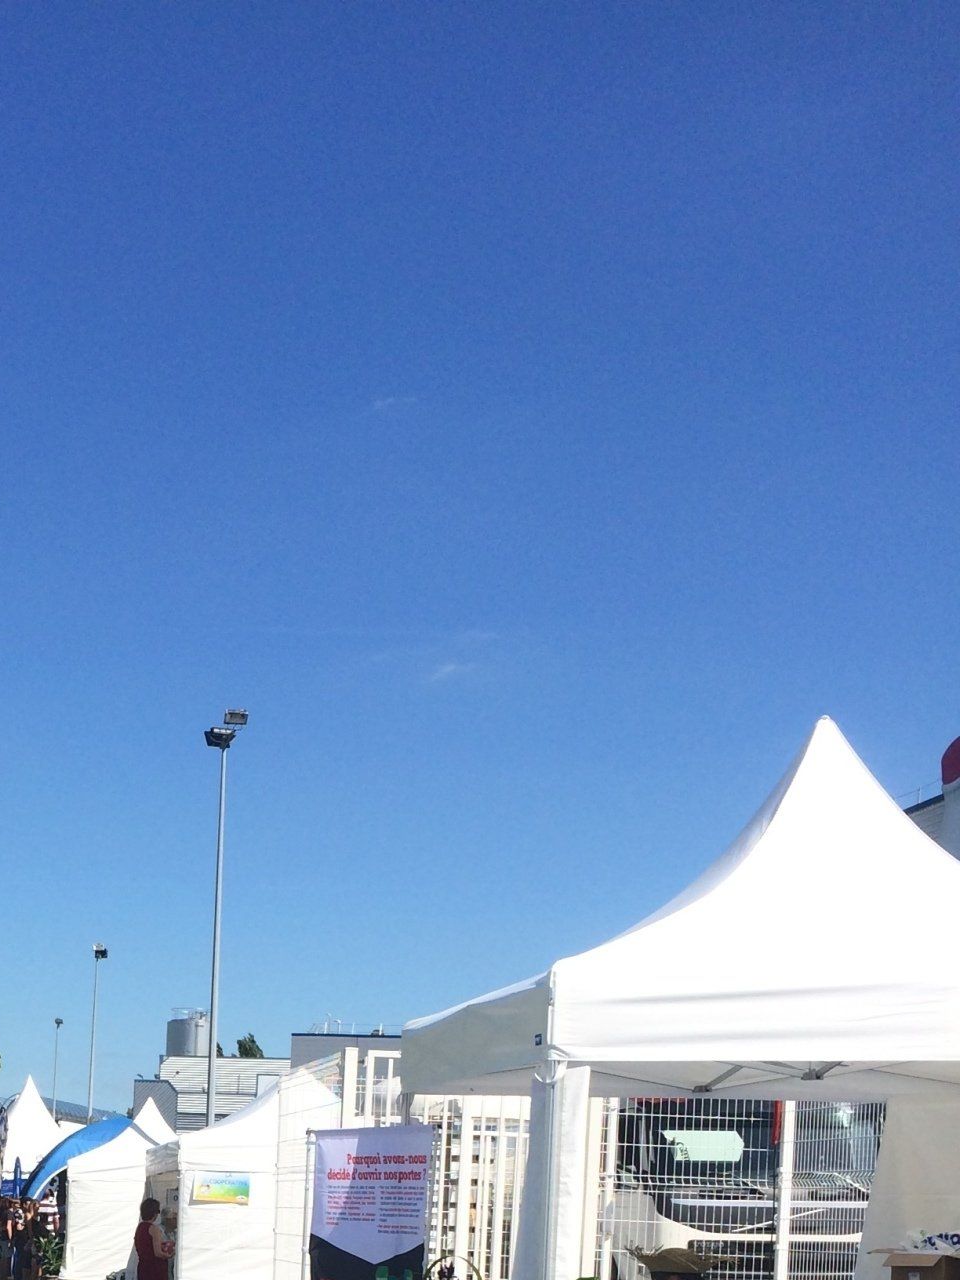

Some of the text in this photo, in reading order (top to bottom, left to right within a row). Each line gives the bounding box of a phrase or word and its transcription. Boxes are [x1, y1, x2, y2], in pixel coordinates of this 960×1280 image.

[347, 1153, 427, 1167] Pourquoi avons-nous
[327, 1168, 350, 1181] décidé
[383, 1171, 398, 1181] nos
[398, 1170, 421, 1184] portes
